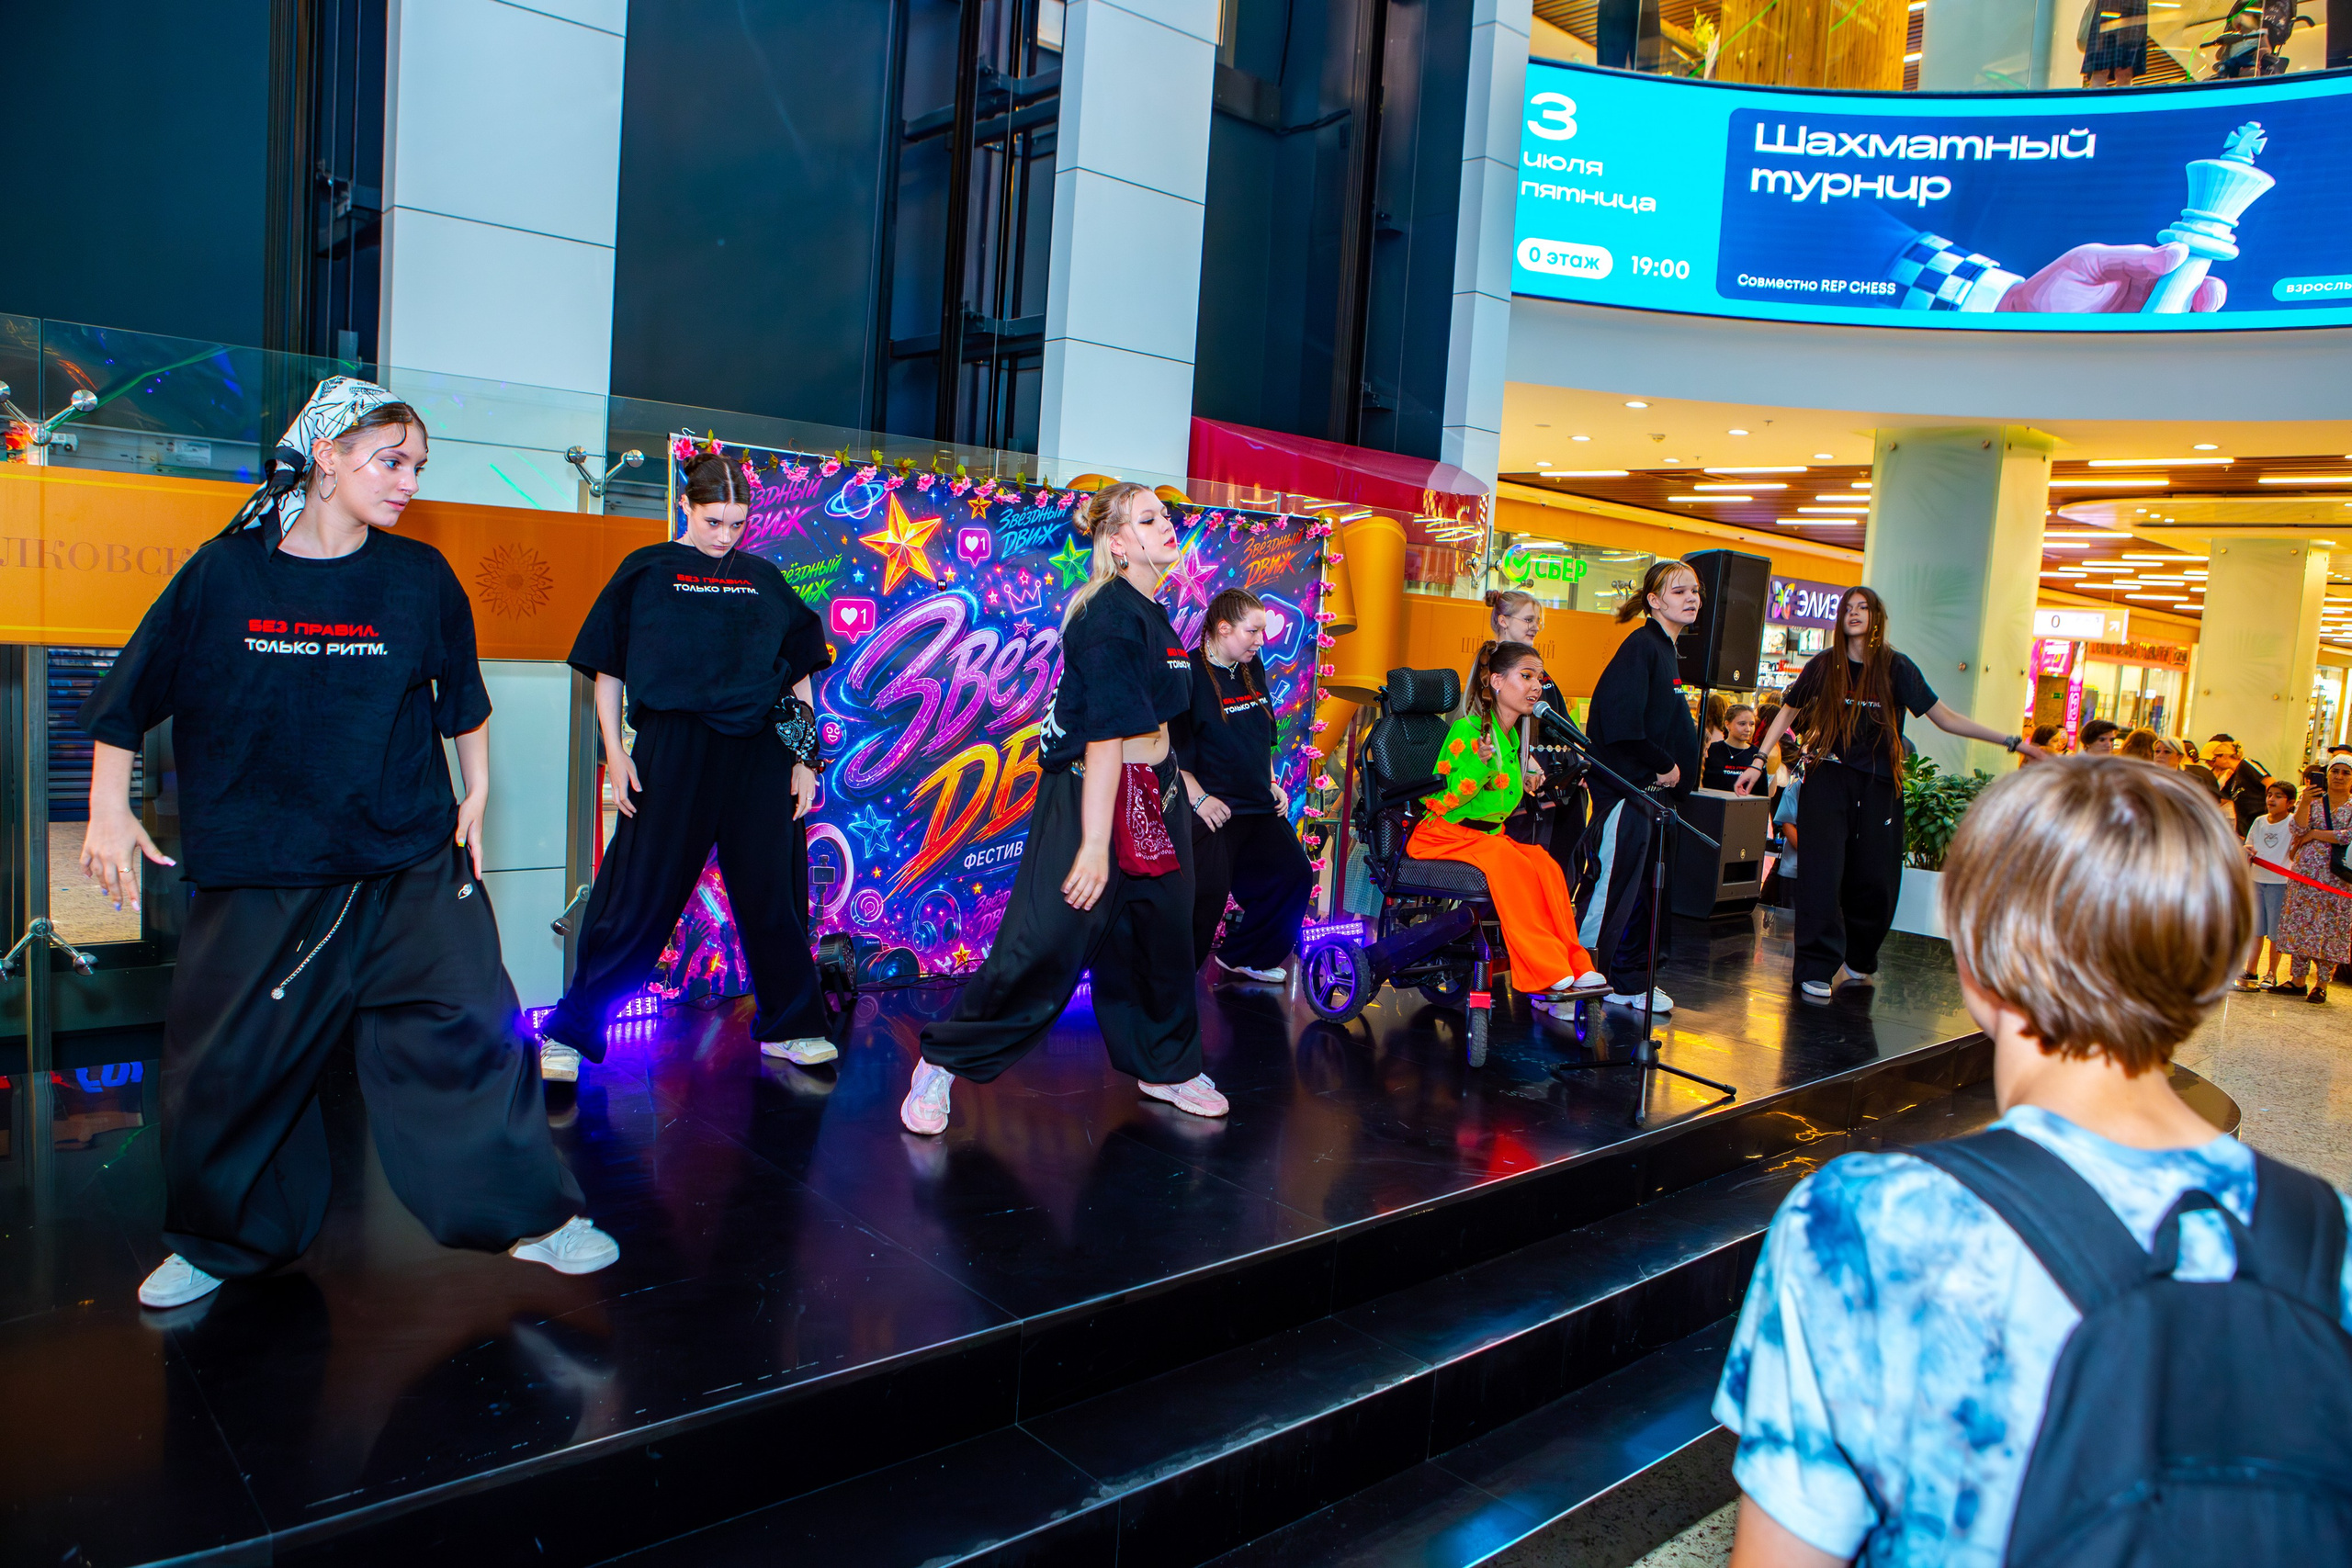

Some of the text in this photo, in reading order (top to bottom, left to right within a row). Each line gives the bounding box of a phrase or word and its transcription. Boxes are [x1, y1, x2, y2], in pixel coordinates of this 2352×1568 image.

[1527, 92, 1577, 141] 3
[1754, 122, 2097, 161] Шахматный
[1523, 151, 1603, 176] июля
[1521, 180, 1657, 214] пятница
[1750, 167, 1952, 208] турнир
[1529, 246, 1600, 270] 0 этаж
[1631, 255, 1690, 279] 19:00
[1736, 273, 1897, 296] Совместно REP CHESS
[676, 573, 700, 582] БЕЗ
[1535, 553, 1588, 582] СБЕР
[673, 583, 759, 595] ТОЛЬКО РИТМ.
[1796, 590, 1842, 621] ЭЛИЗ
[248, 619, 379, 637] БЕЗ ПРАВИЛ.
[244, 637, 389, 656] ТОЛЬКО РИТМ.
[964, 840, 1023, 870] ФЕСТИВ
